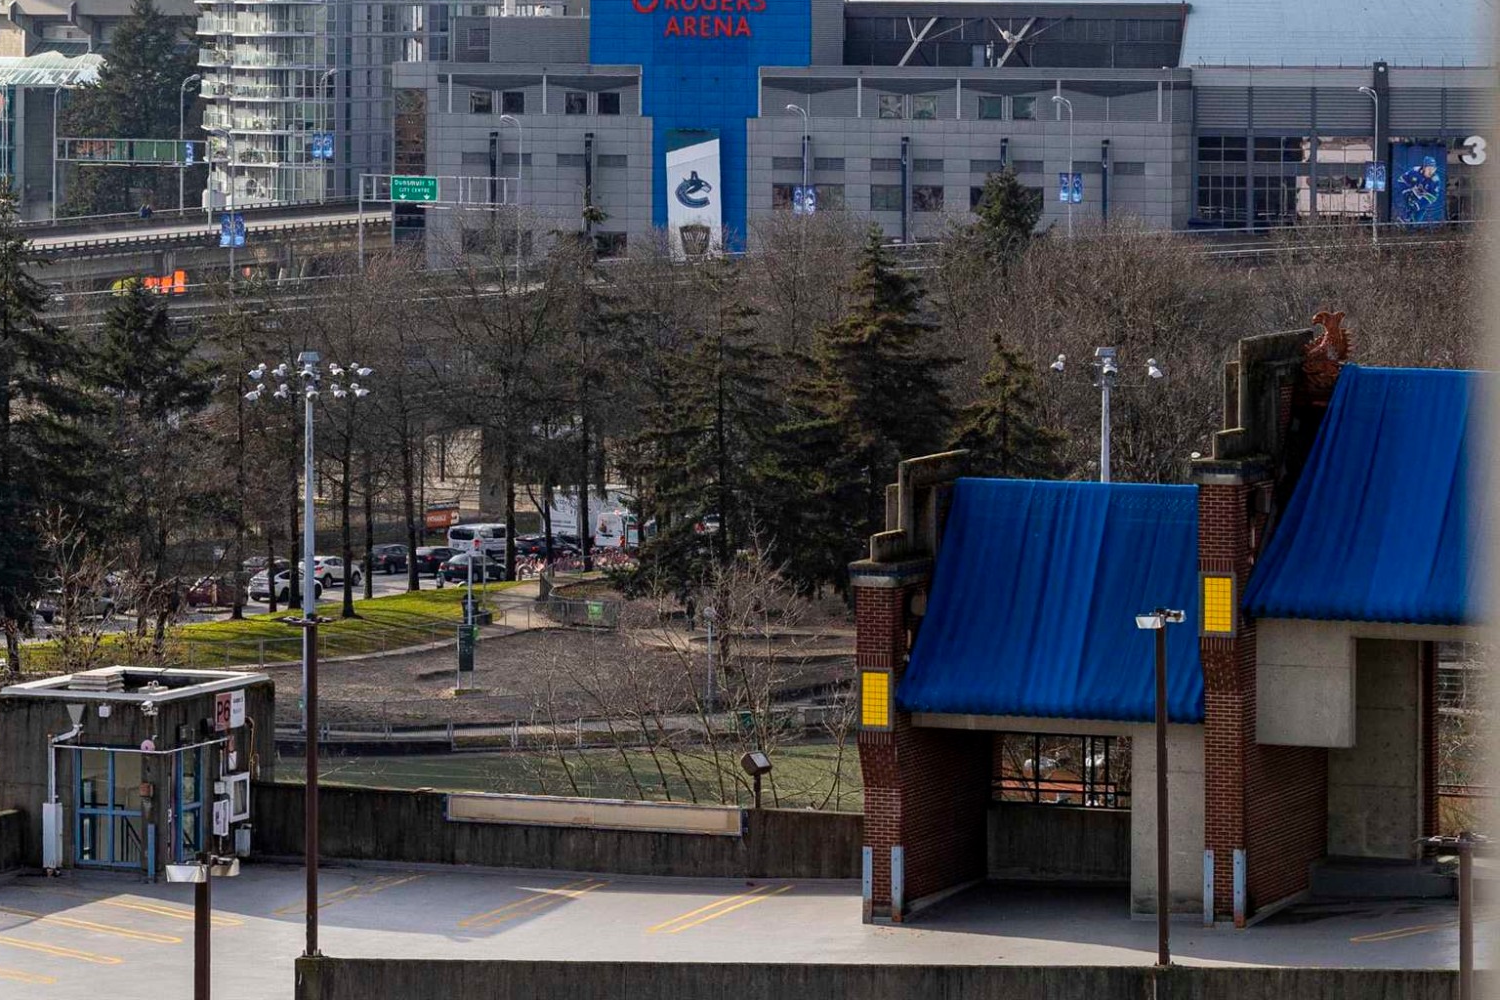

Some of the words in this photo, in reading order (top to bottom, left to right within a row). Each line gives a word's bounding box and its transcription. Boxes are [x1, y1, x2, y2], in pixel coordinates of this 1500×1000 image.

[664, 15, 752, 38] ARENA
[1462, 135, 1487, 165] 3
[217, 699, 231, 723] P6
